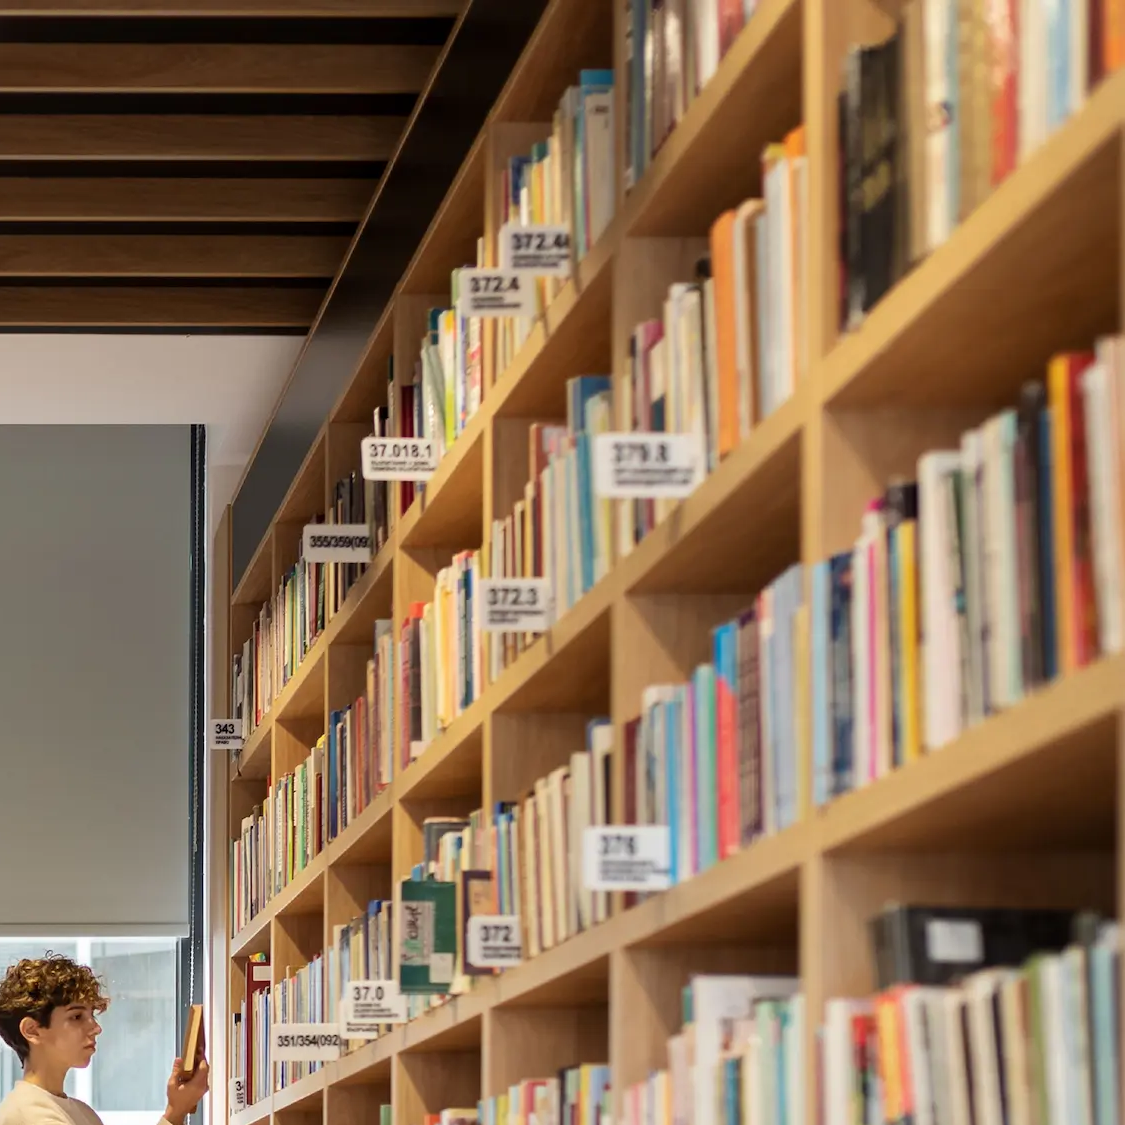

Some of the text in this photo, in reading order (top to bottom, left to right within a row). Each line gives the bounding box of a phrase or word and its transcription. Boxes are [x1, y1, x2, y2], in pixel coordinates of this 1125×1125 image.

[470, 276, 520, 293] 372.4
[369, 443, 432, 458] 37.018.1
[488, 587, 538, 605] 372.3
[215, 723, 235, 734] 343
[481, 925, 512, 942] 372
[353, 986, 384, 1001] 37.0
